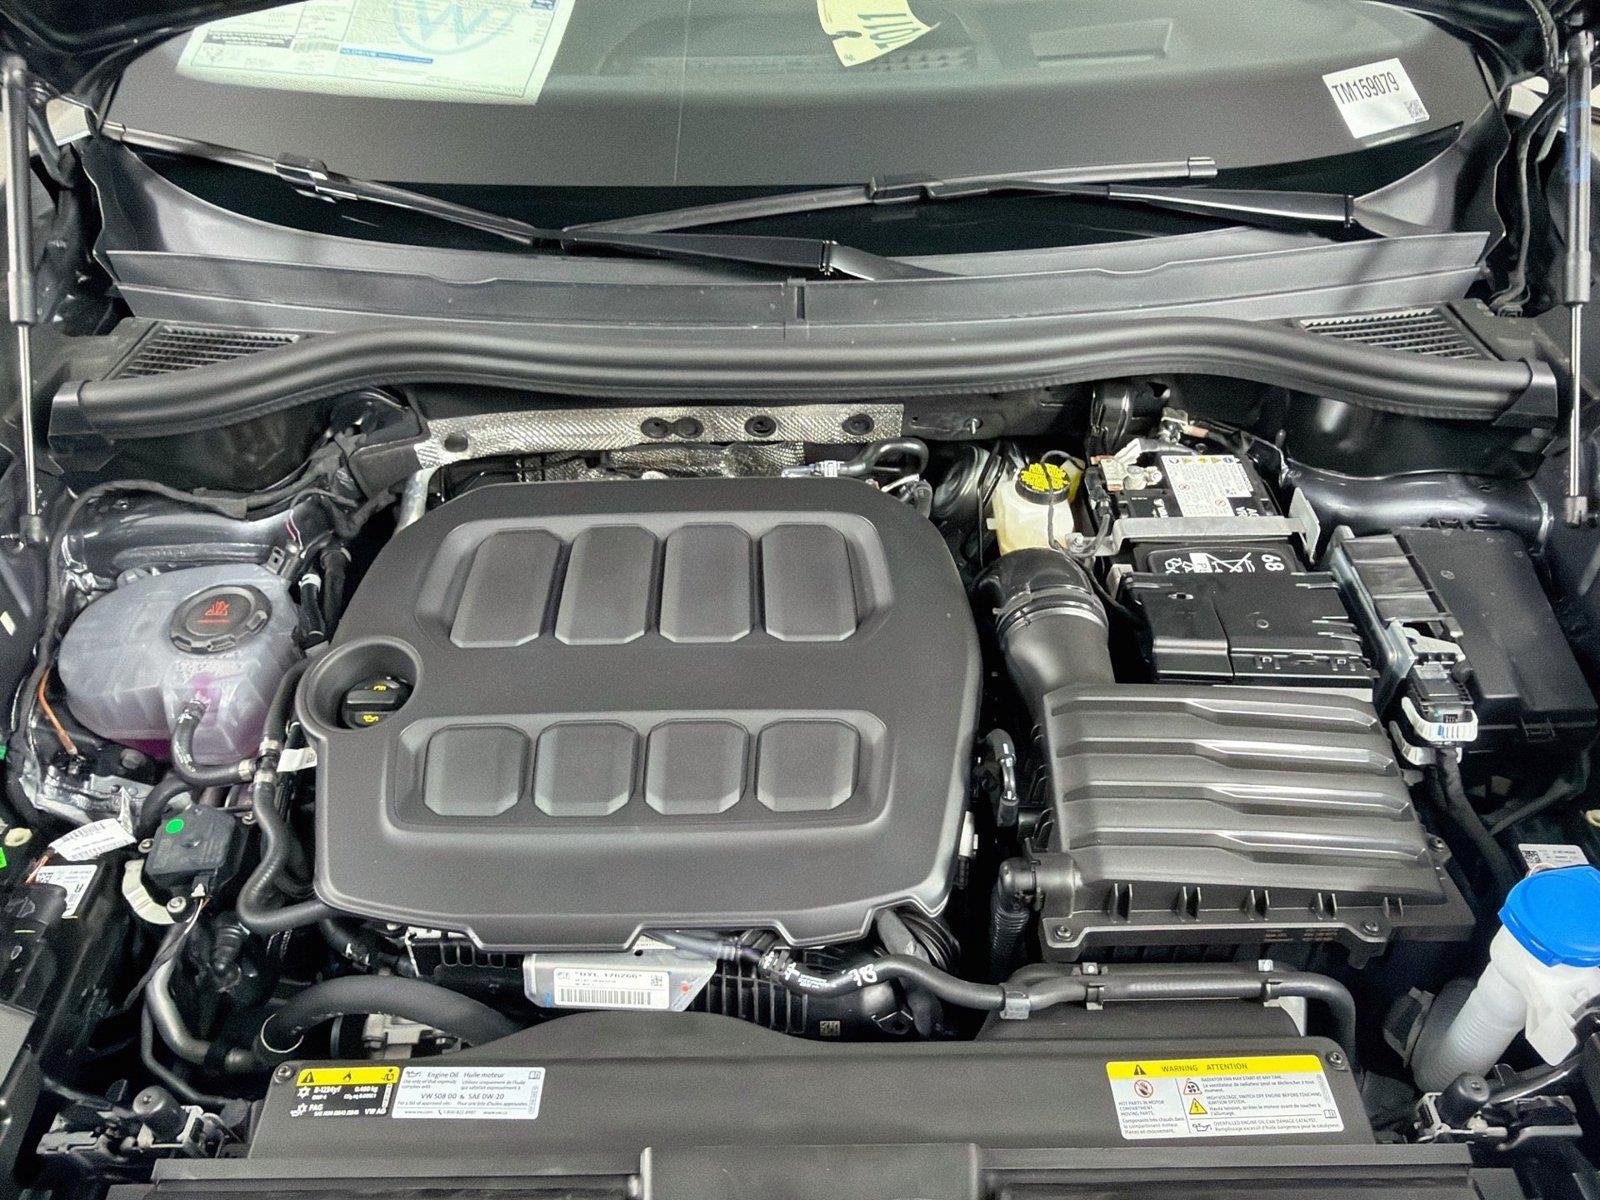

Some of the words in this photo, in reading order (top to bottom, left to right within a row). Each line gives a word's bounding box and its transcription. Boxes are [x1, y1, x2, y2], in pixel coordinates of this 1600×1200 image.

[1331, 71, 1400, 105] TM159079
[1261, 554, 1285, 571] 68
[1161, 1064, 1199, 1072] WARNING
[1206, 1062, 1249, 1071] ATTENTION
[427, 1071, 449, 1080] Engine
[463, 1071, 481, 1079] Huile
[481, 1071, 506, 1079] moteur
